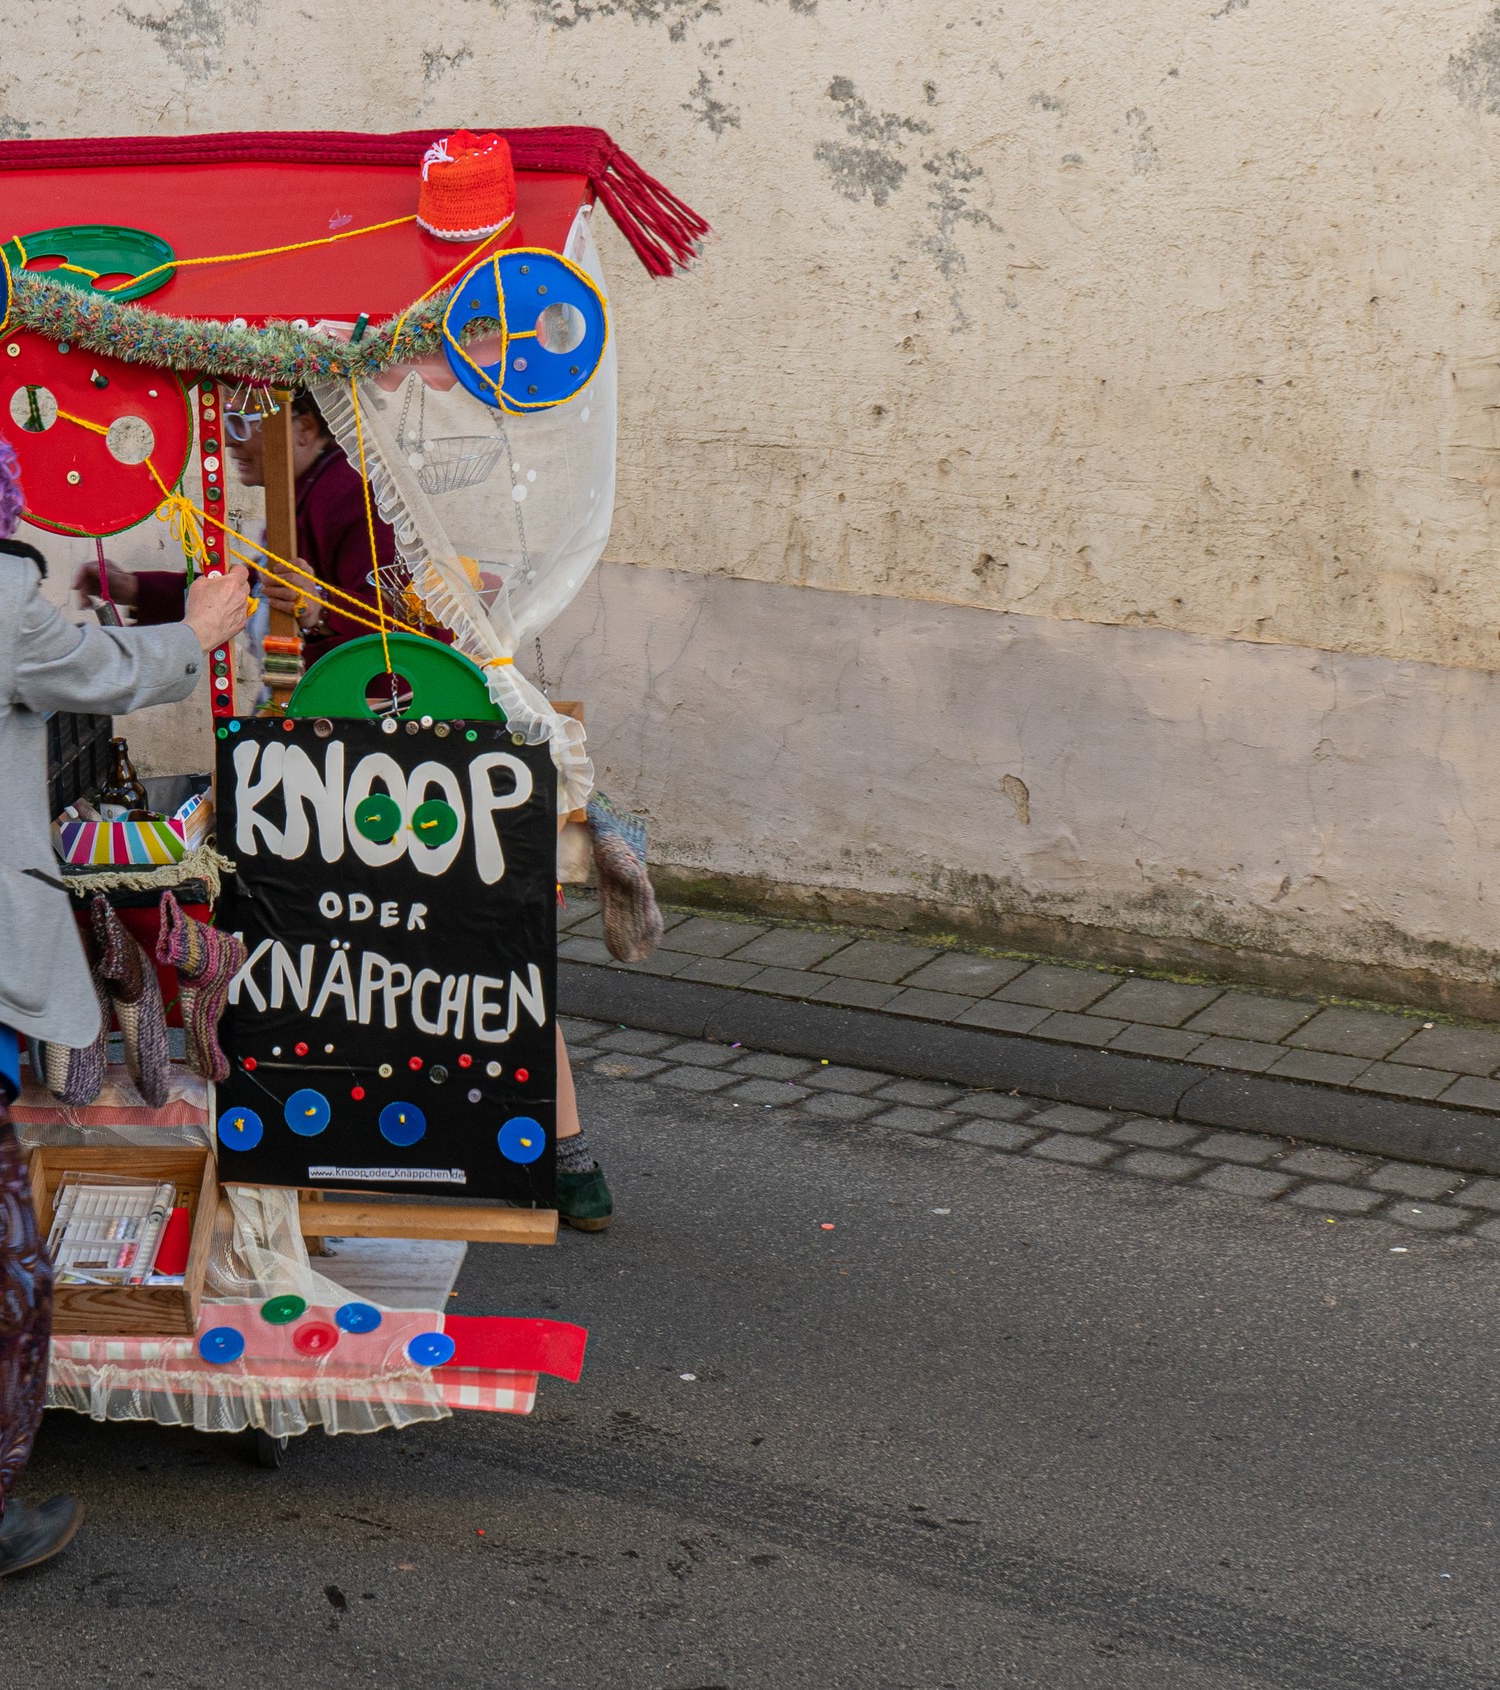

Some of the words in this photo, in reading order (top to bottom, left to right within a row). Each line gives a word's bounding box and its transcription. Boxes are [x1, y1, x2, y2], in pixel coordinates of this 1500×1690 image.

[233, 740, 533, 885] KNOOP
[318, 891, 429, 930] ODER
[228, 931, 546, 1043] KNÄPPCHEN
